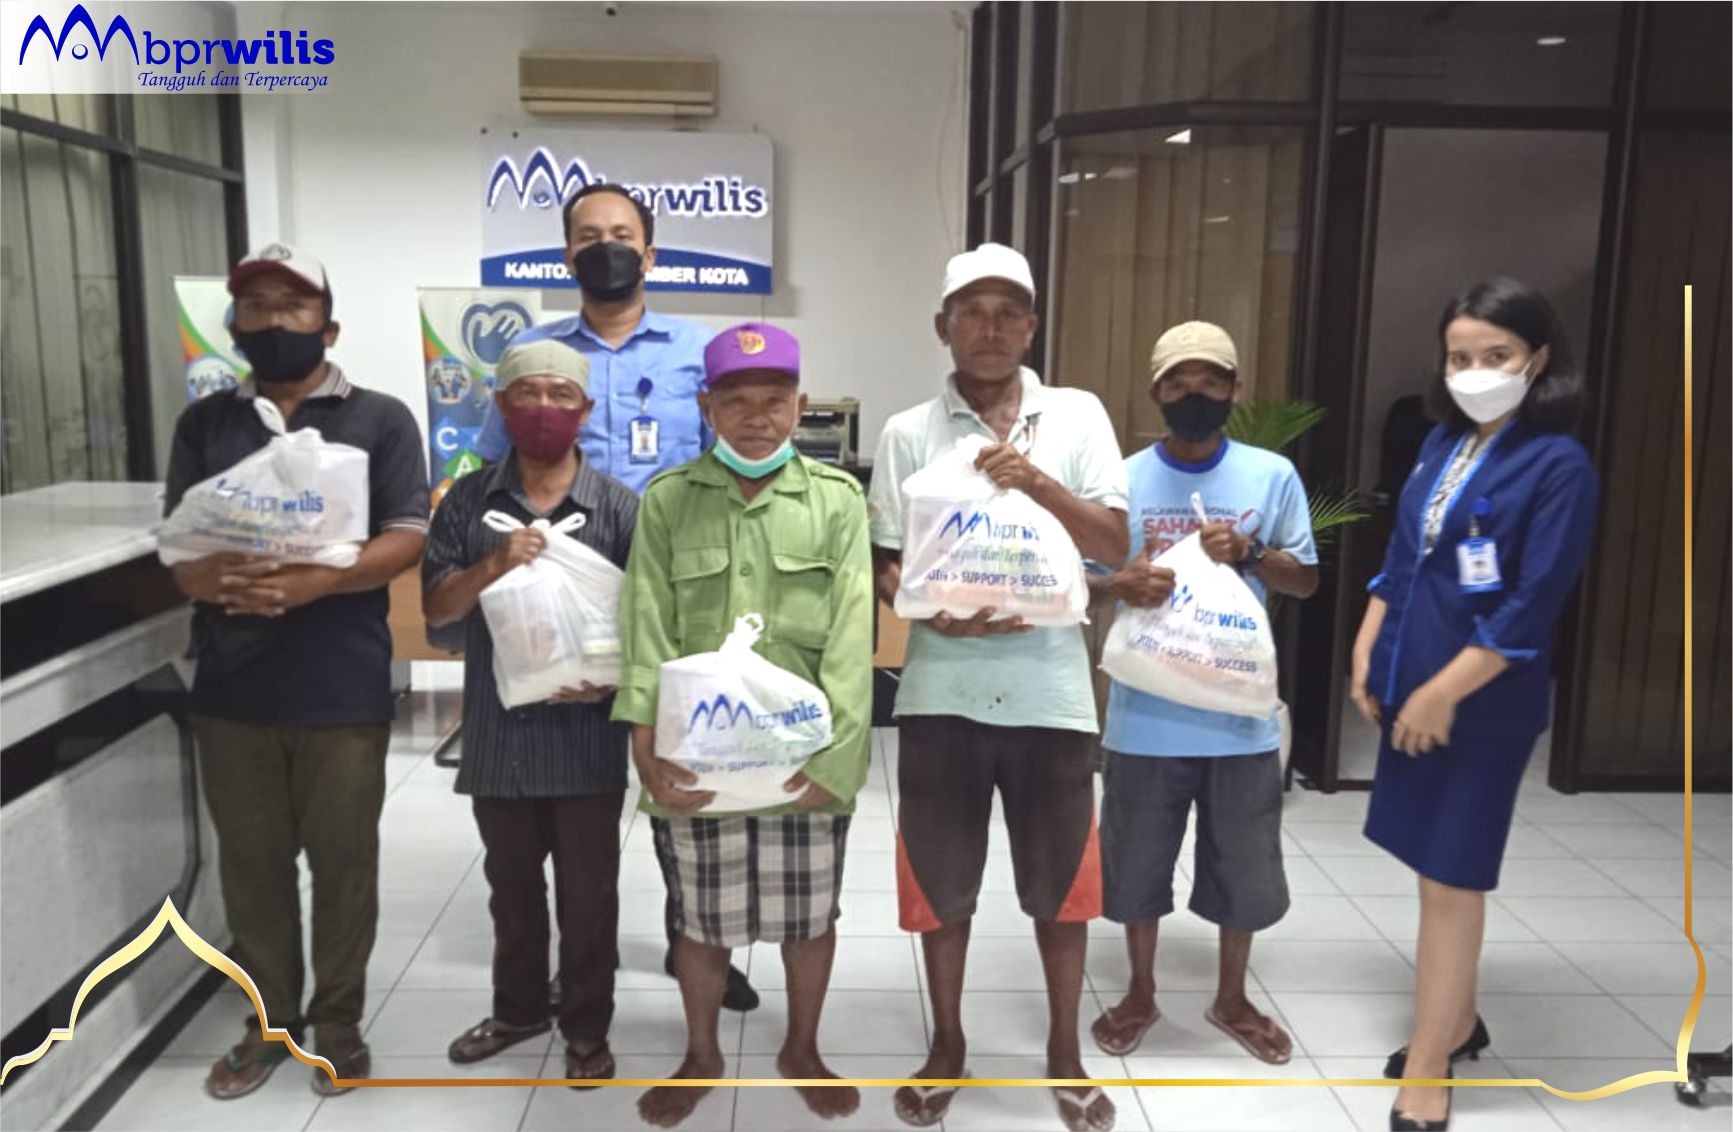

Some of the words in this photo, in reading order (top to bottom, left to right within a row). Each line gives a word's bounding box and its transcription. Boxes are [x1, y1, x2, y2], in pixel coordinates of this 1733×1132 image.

[505, 262, 572, 280] KANTO
[644, 267, 696, 284] MBER
[699, 268, 748, 285] KOTA
[961, 570, 1007, 587] SUPPORT
[1214, 657, 1257, 673] SUCCESS
